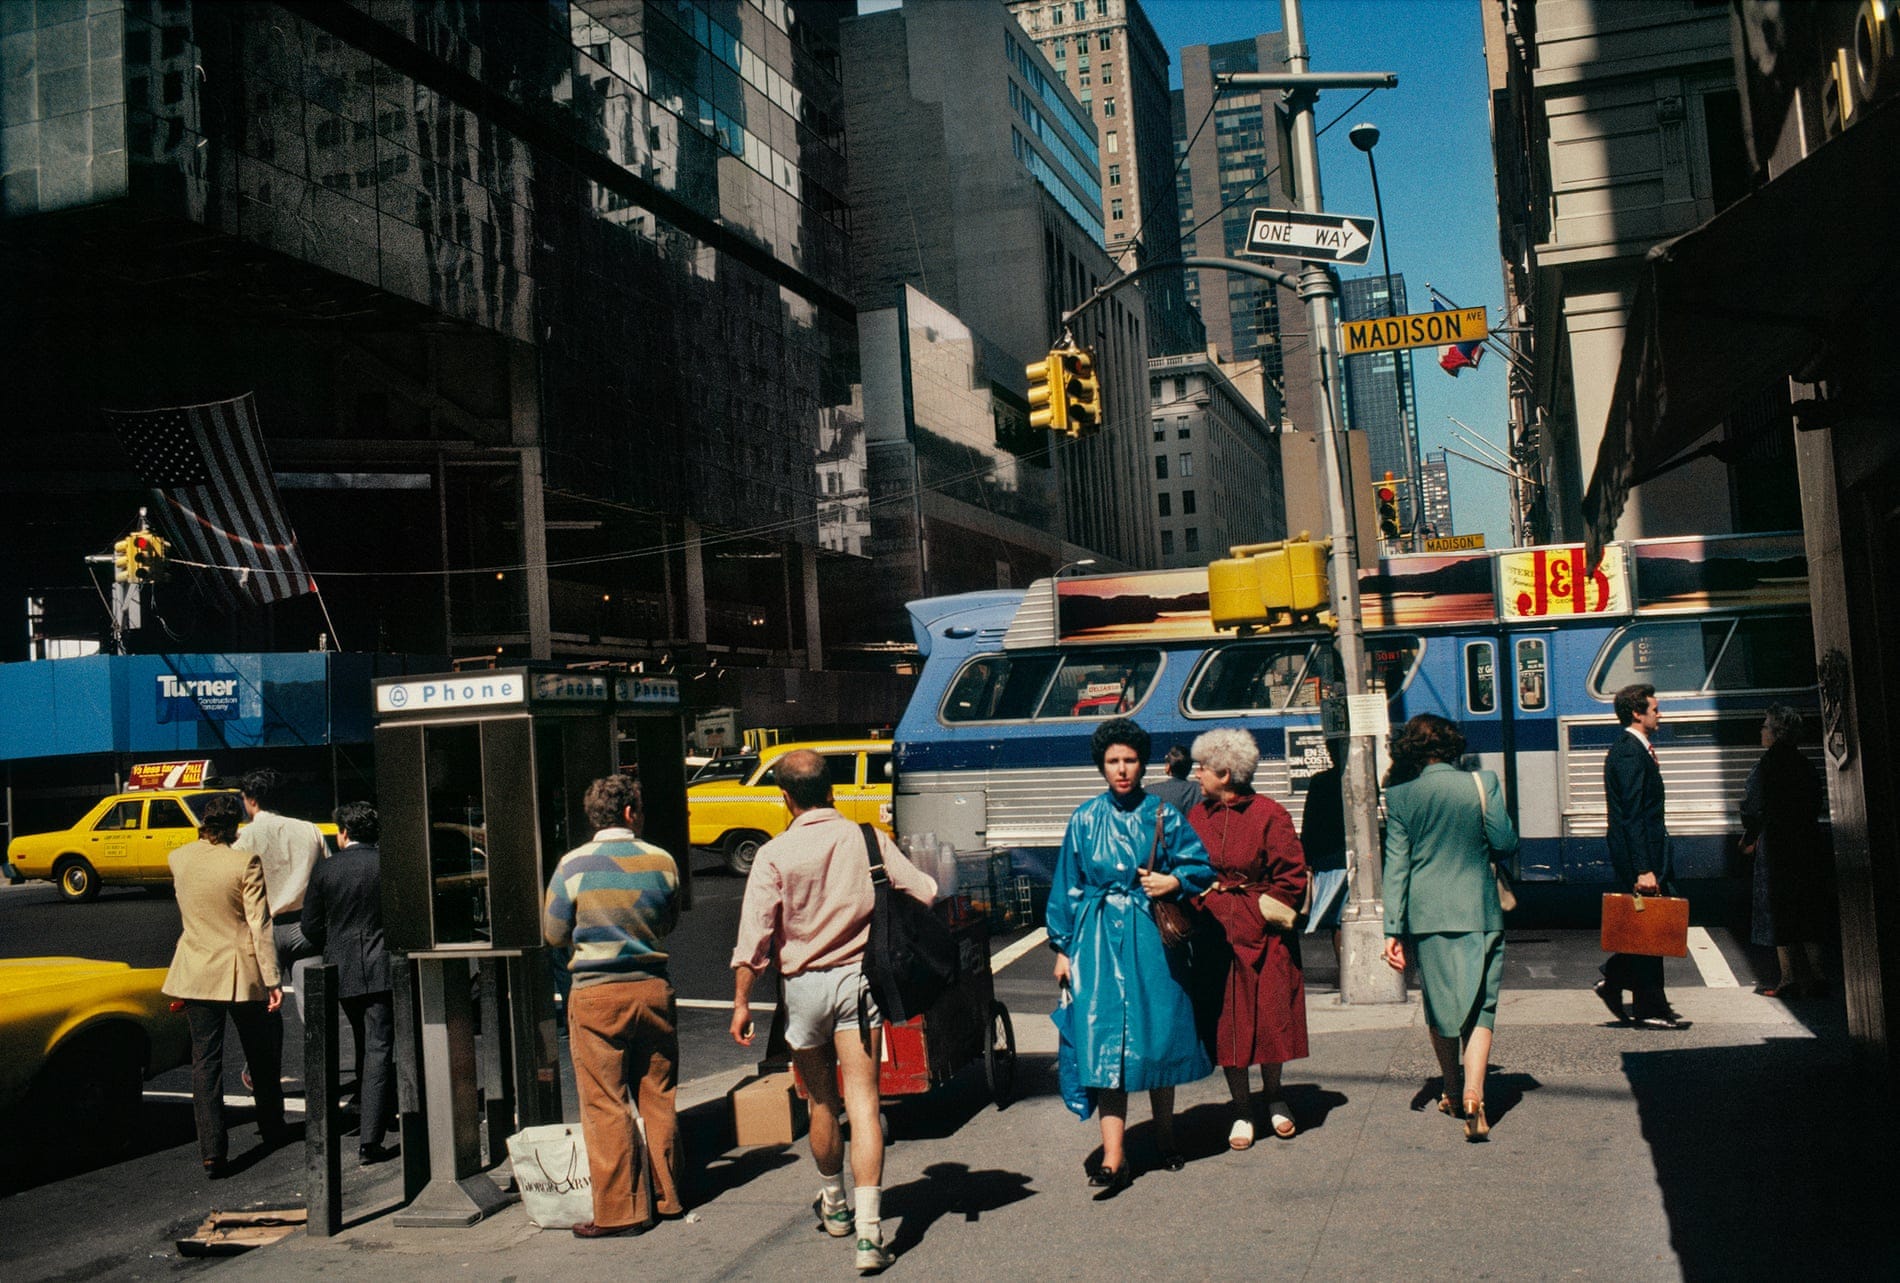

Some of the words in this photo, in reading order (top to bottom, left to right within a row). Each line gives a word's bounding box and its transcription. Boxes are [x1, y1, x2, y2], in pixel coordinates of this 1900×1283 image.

[1259, 224, 1292, 242] ONE
[1315, 228, 1353, 248] WAY
[1350, 314, 1462, 349] MADISON
[1466, 311, 1483, 321] AVE
[1427, 536, 1474, 552] MADISON
[157, 675, 237, 697] Turner
[423, 682, 513, 702] Phone
[635, 682, 677, 698] Phone
